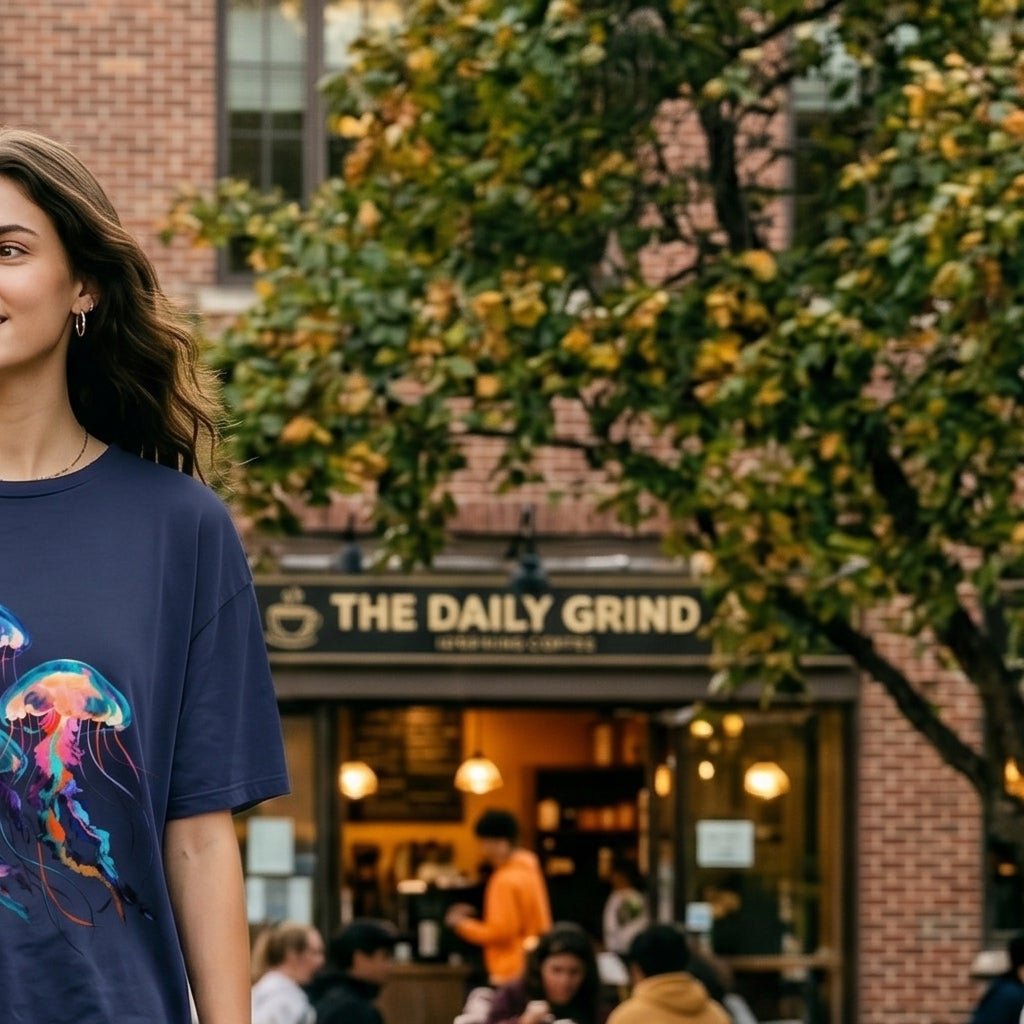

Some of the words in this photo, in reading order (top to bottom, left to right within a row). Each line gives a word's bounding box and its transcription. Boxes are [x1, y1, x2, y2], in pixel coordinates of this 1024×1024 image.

[330, 593, 418, 631] THE
[427, 593, 552, 633] DAILY
[561, 595, 702, 634] GRIND
